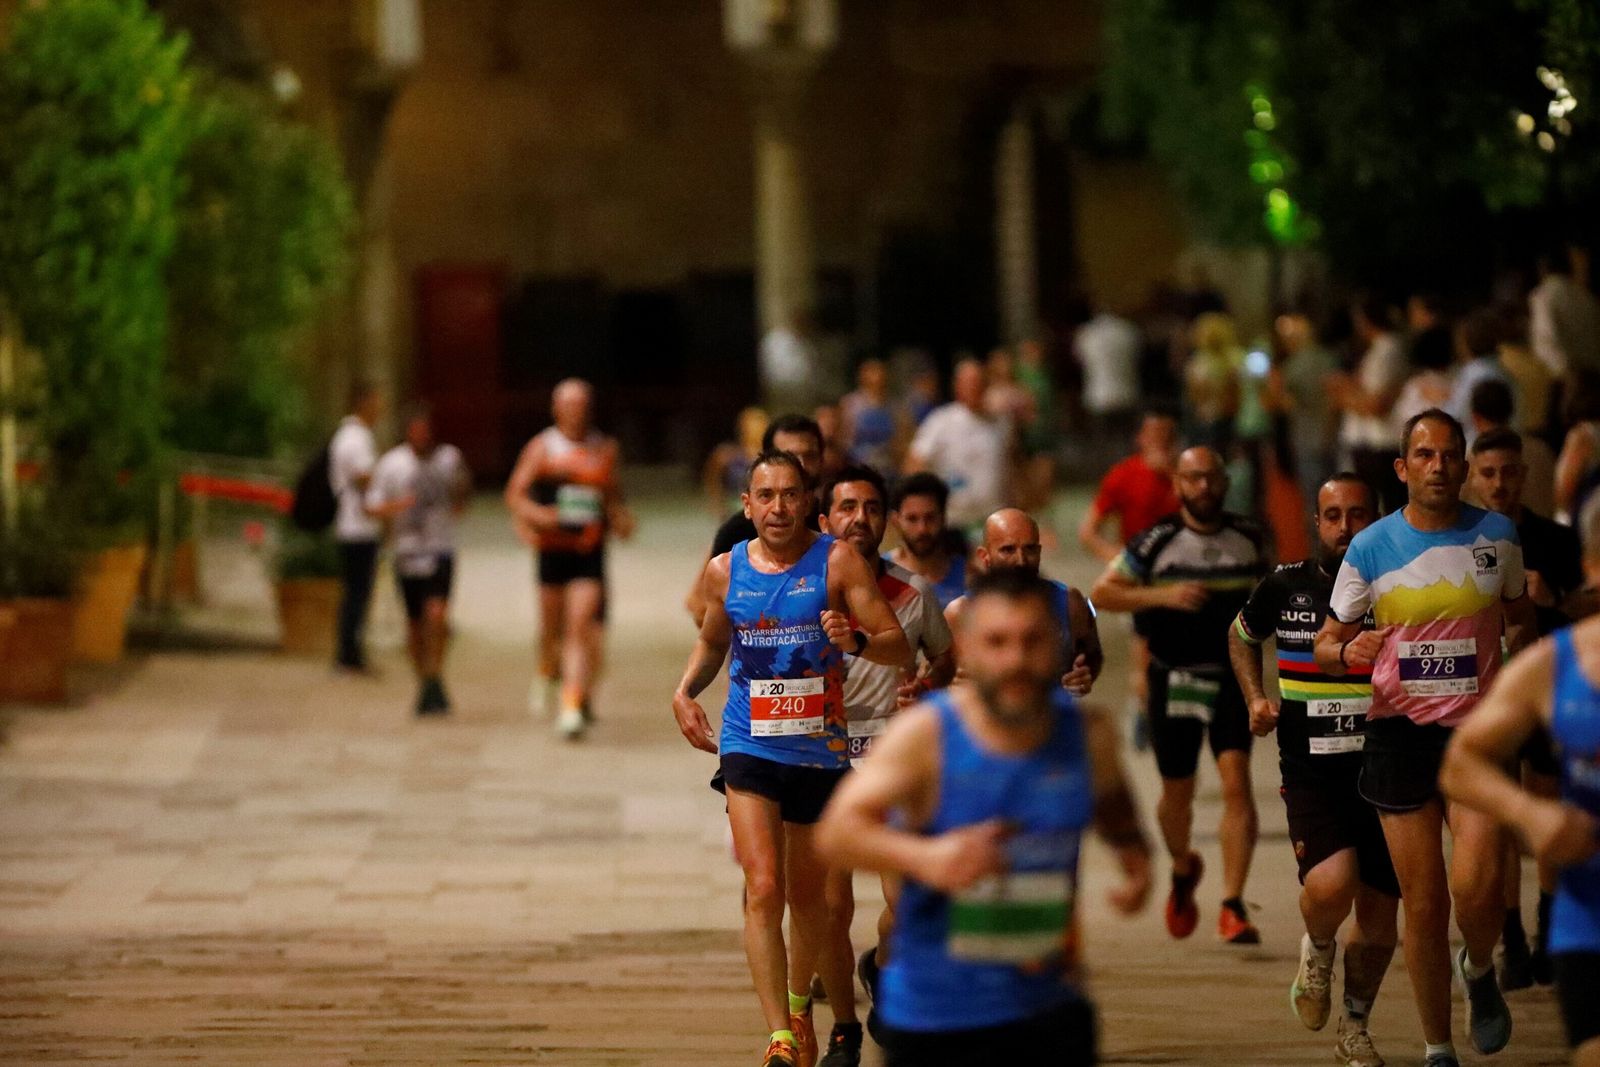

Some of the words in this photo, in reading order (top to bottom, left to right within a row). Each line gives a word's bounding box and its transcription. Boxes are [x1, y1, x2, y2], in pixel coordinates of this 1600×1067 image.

[1286, 610, 1316, 623] UCI
[751, 628, 784, 637] CARRERA
[785, 624, 820, 635] NOCTURNA
[753, 631, 821, 647] TROTACALLES
[1420, 644, 1435, 656] 20
[1421, 657, 1455, 675] 978
[769, 683, 785, 695] 20
[769, 696, 805, 715] 240
[1327, 702, 1341, 714] 20
[1334, 715, 1356, 732] 14
[848, 737, 872, 754] 84
